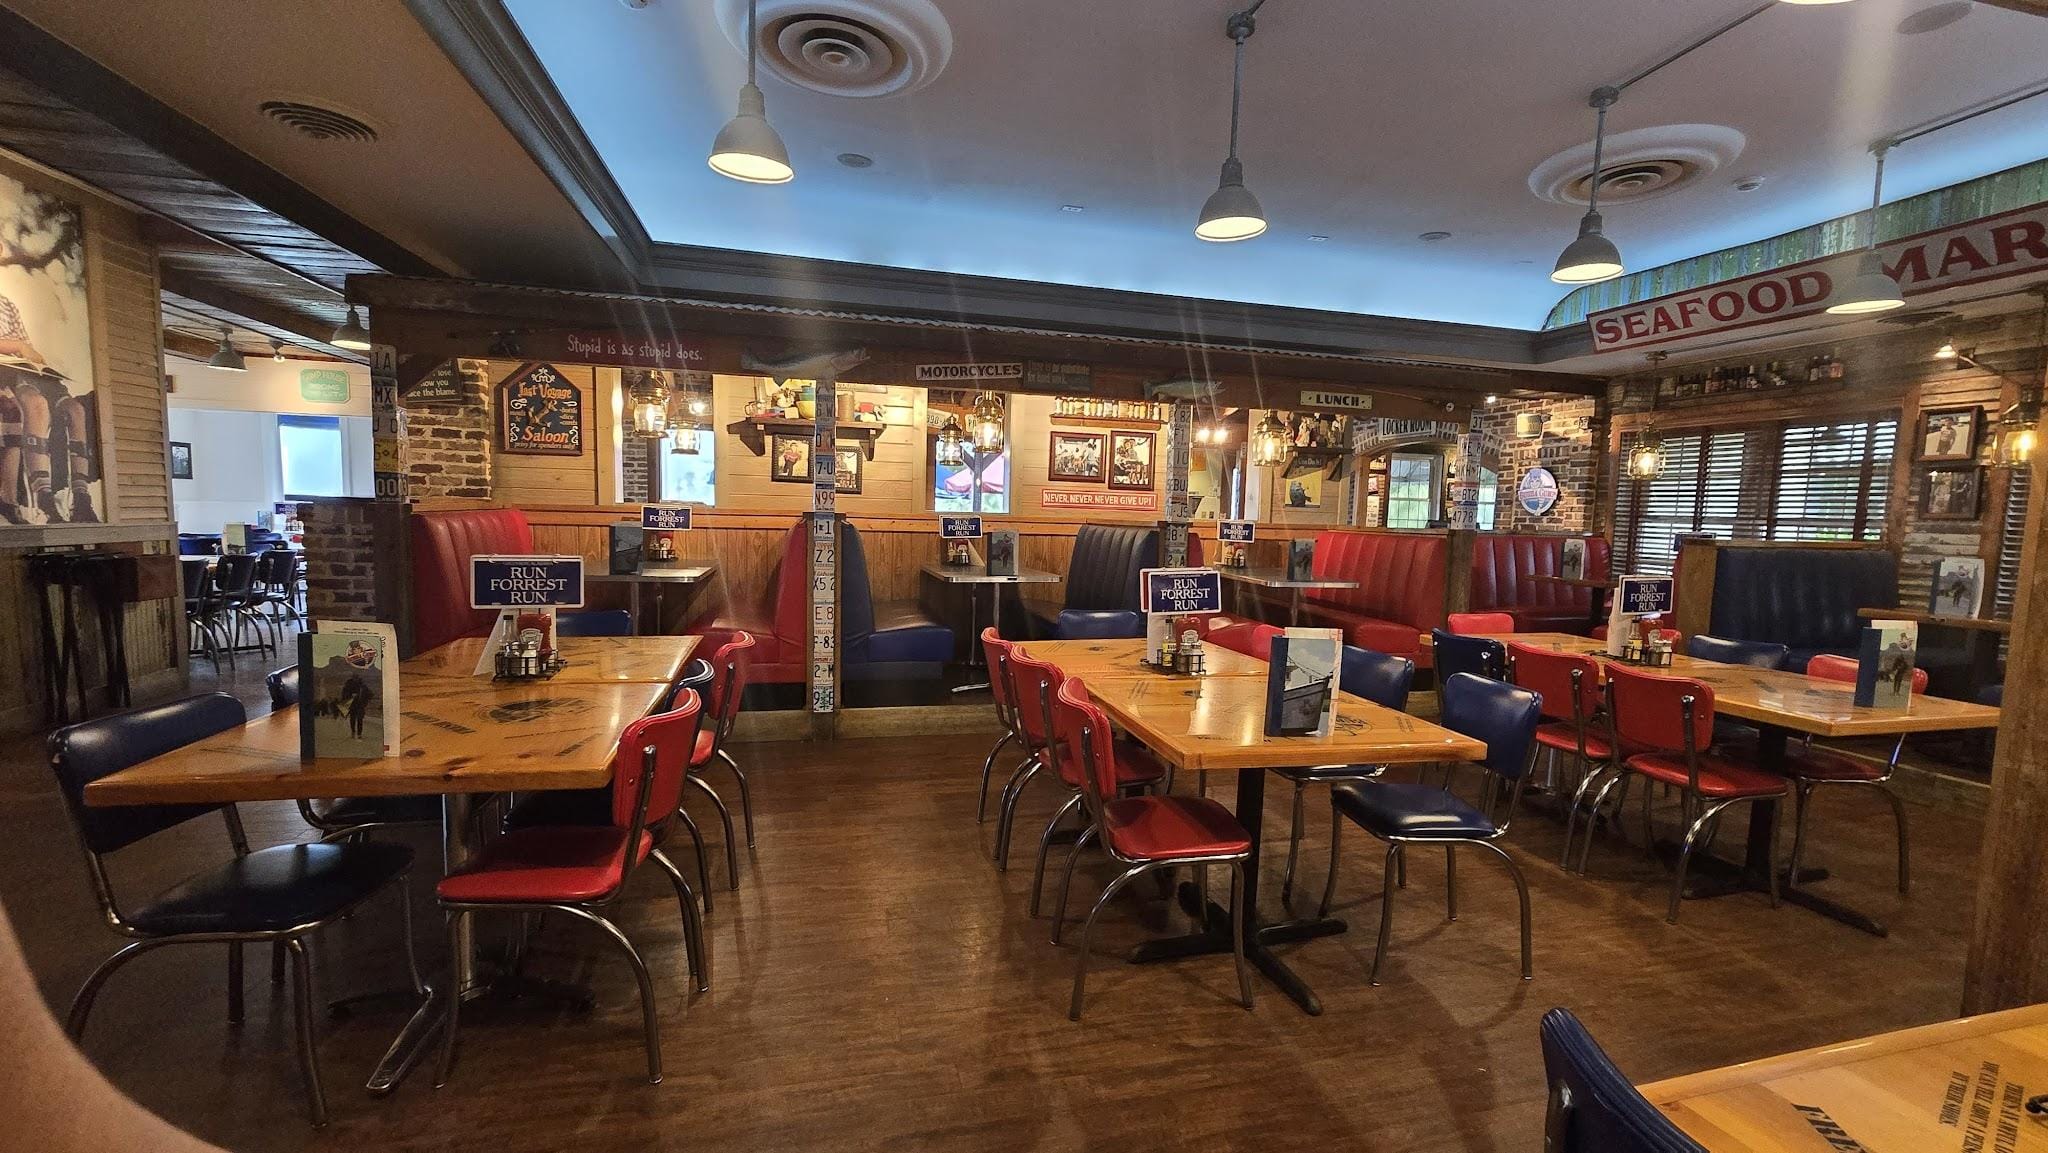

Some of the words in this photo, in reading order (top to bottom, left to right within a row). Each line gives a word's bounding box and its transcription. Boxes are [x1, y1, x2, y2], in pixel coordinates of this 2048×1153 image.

[1596, 269, 1833, 344] SEAFOOD
[567, 334, 601, 358] Stupid
[607, 338, 617, 355] is
[621, 344, 634, 357] as
[639, 341, 671, 362] stupid
[676, 344, 703, 361] does.
[920, 364, 1022, 378] MOTORCYCLES
[422, 388, 435, 397] the
[538, 383, 572, 400] Voyage
[1316, 394, 1360, 407] LUNCH
[522, 425, 569, 443] Saloon
[1382, 419, 1409, 436] LOCKER
[1095, 494, 1119, 505] NEVER
[1119, 495, 1137, 506] GIVE
[649, 515, 685, 523] FORREST
[510, 566, 548, 579] RUN
[490, 578, 568, 591] FORREST
[1173, 578, 1198, 589] RUN
[1640, 583, 1658, 593] RUN
[510, 591, 547, 604] RUN
[1160, 588, 1211, 600] FORREST
[1630, 592, 1666, 603] FORREST
[1174, 599, 1199, 611] RUN
[1638, 602, 1657, 612] RUN
